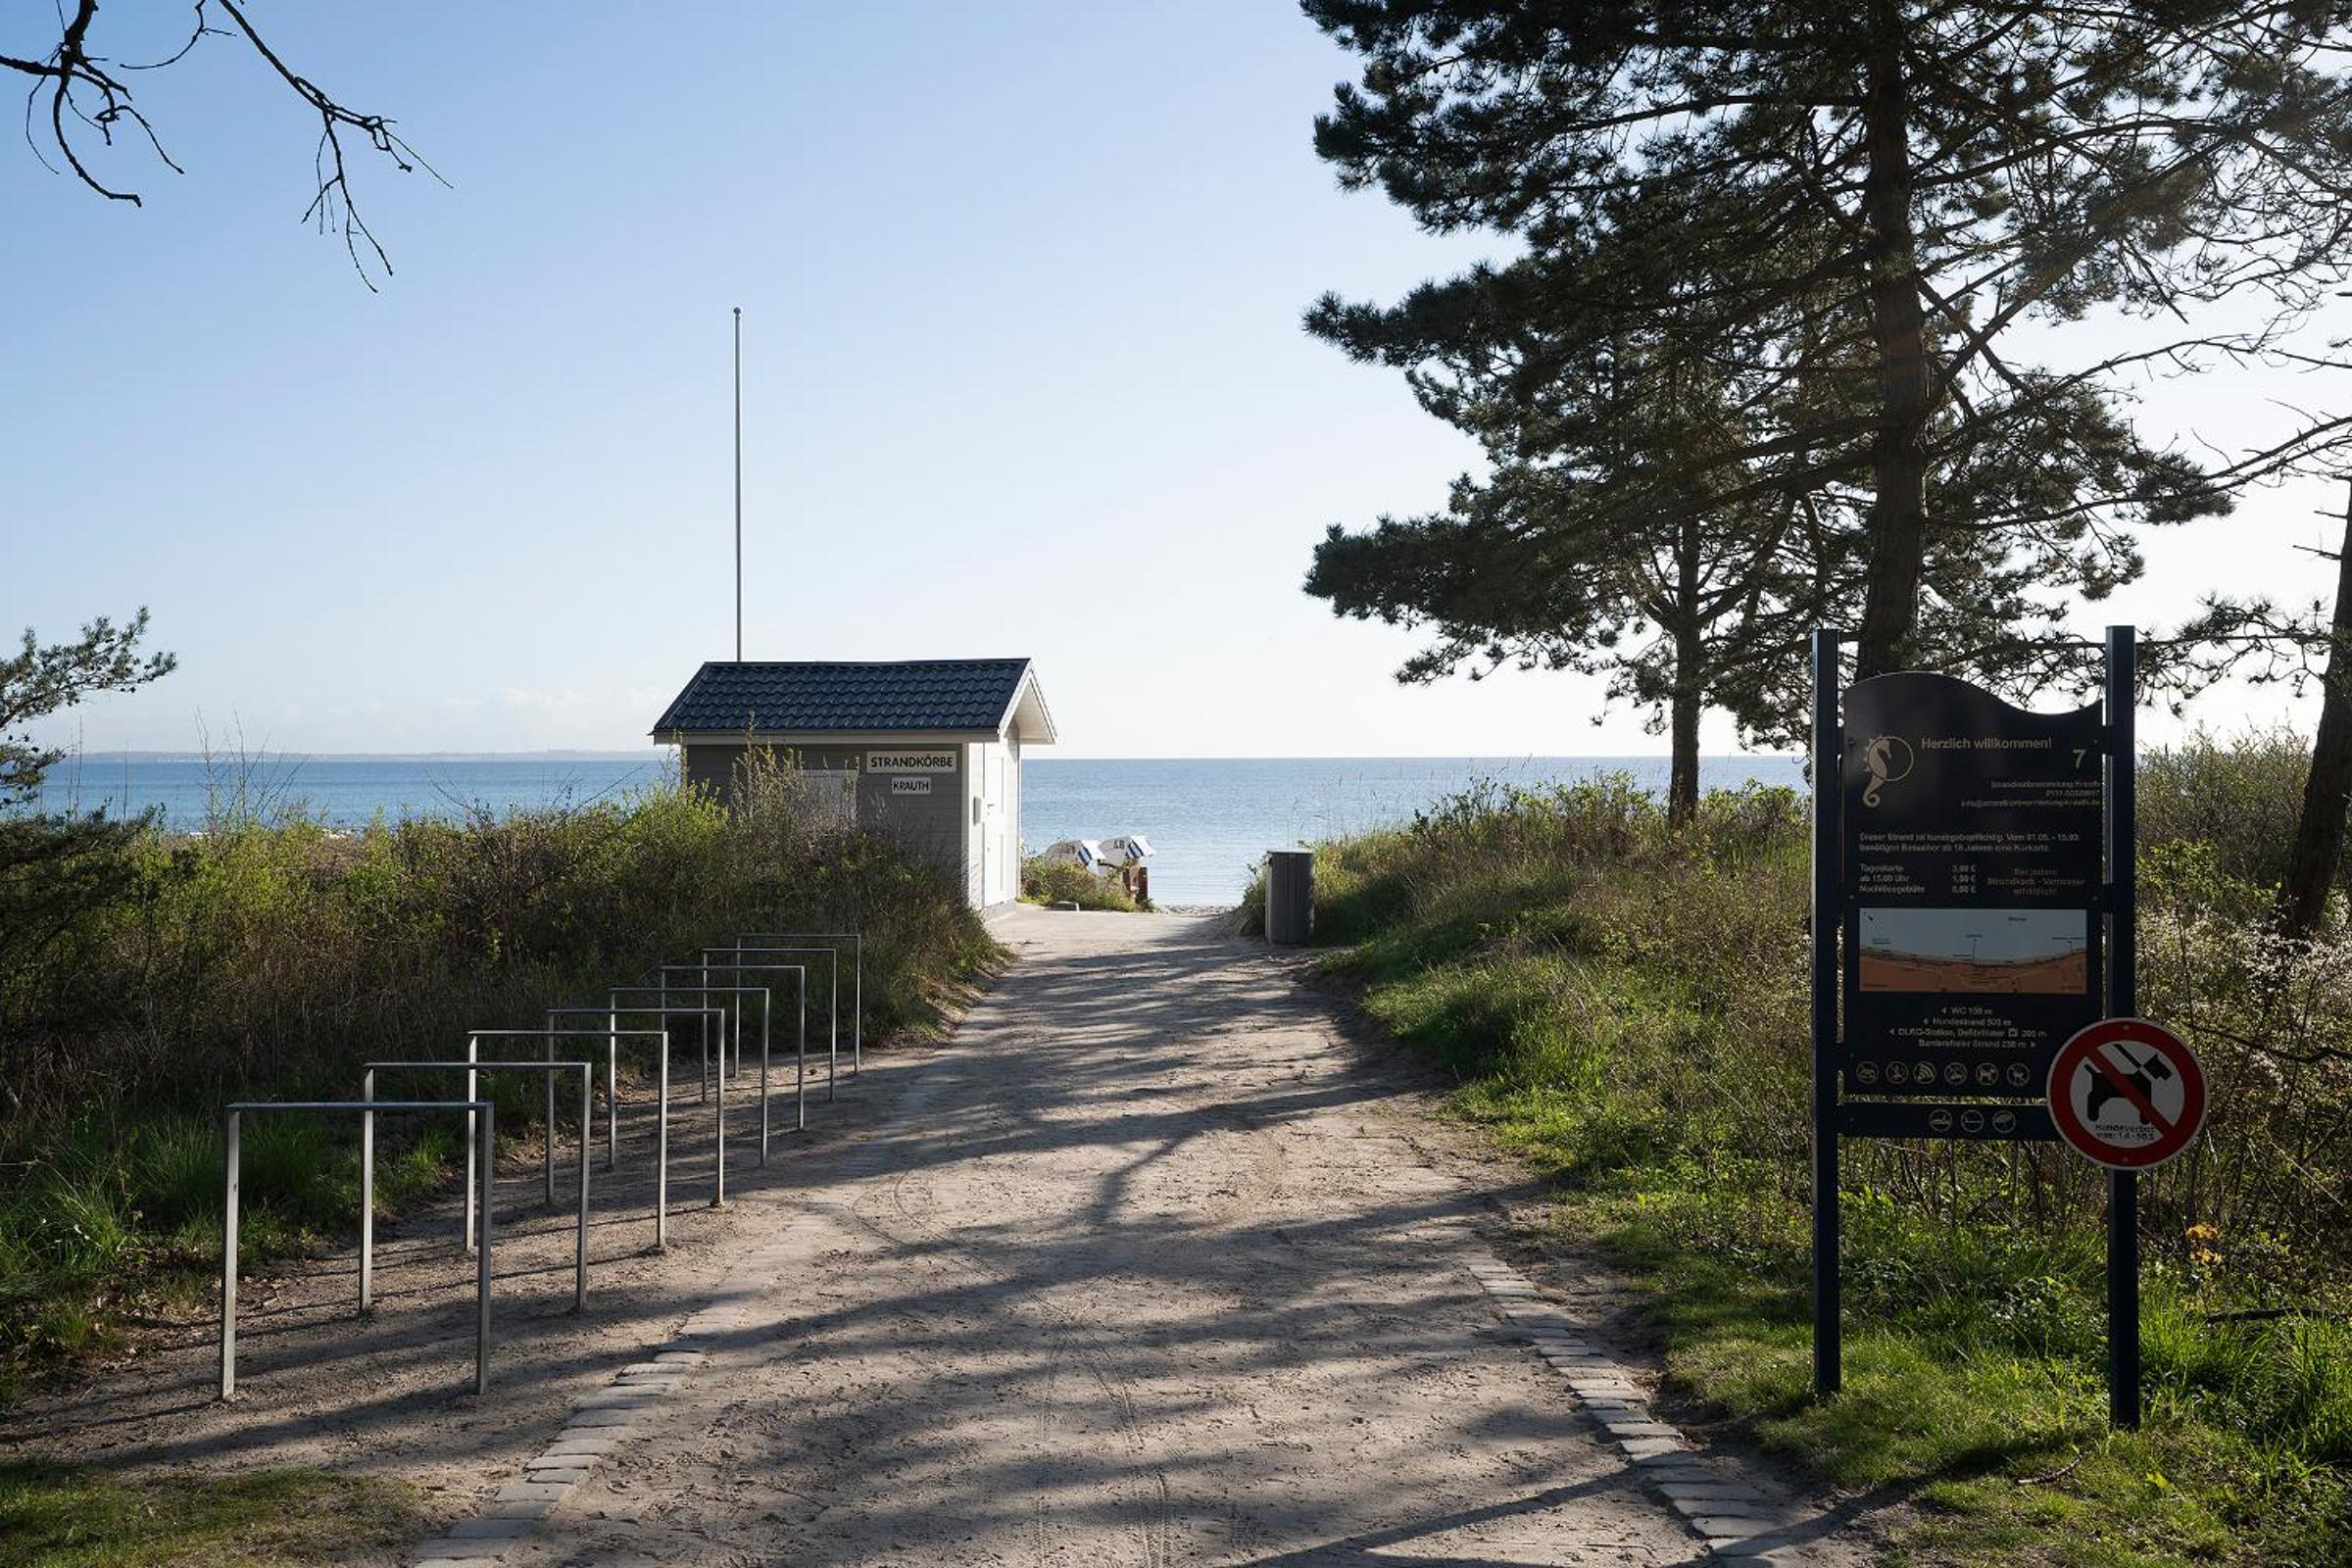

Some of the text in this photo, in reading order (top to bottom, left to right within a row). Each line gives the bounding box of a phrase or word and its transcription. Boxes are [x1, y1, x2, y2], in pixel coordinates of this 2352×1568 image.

[1921, 736, 2052, 750] Herzlich willkommen!
[870, 754, 954, 767] STRANDKÖRBE
[2072, 748, 2086, 768] 7
[893, 780, 929, 791] KRAUTH
[1859, 833, 1886, 842] Dieser
[1887, 833, 1914, 842] Strand
[1859, 863, 1904, 873] Tageskarte
[1951, 1006, 1967, 1015] WC
